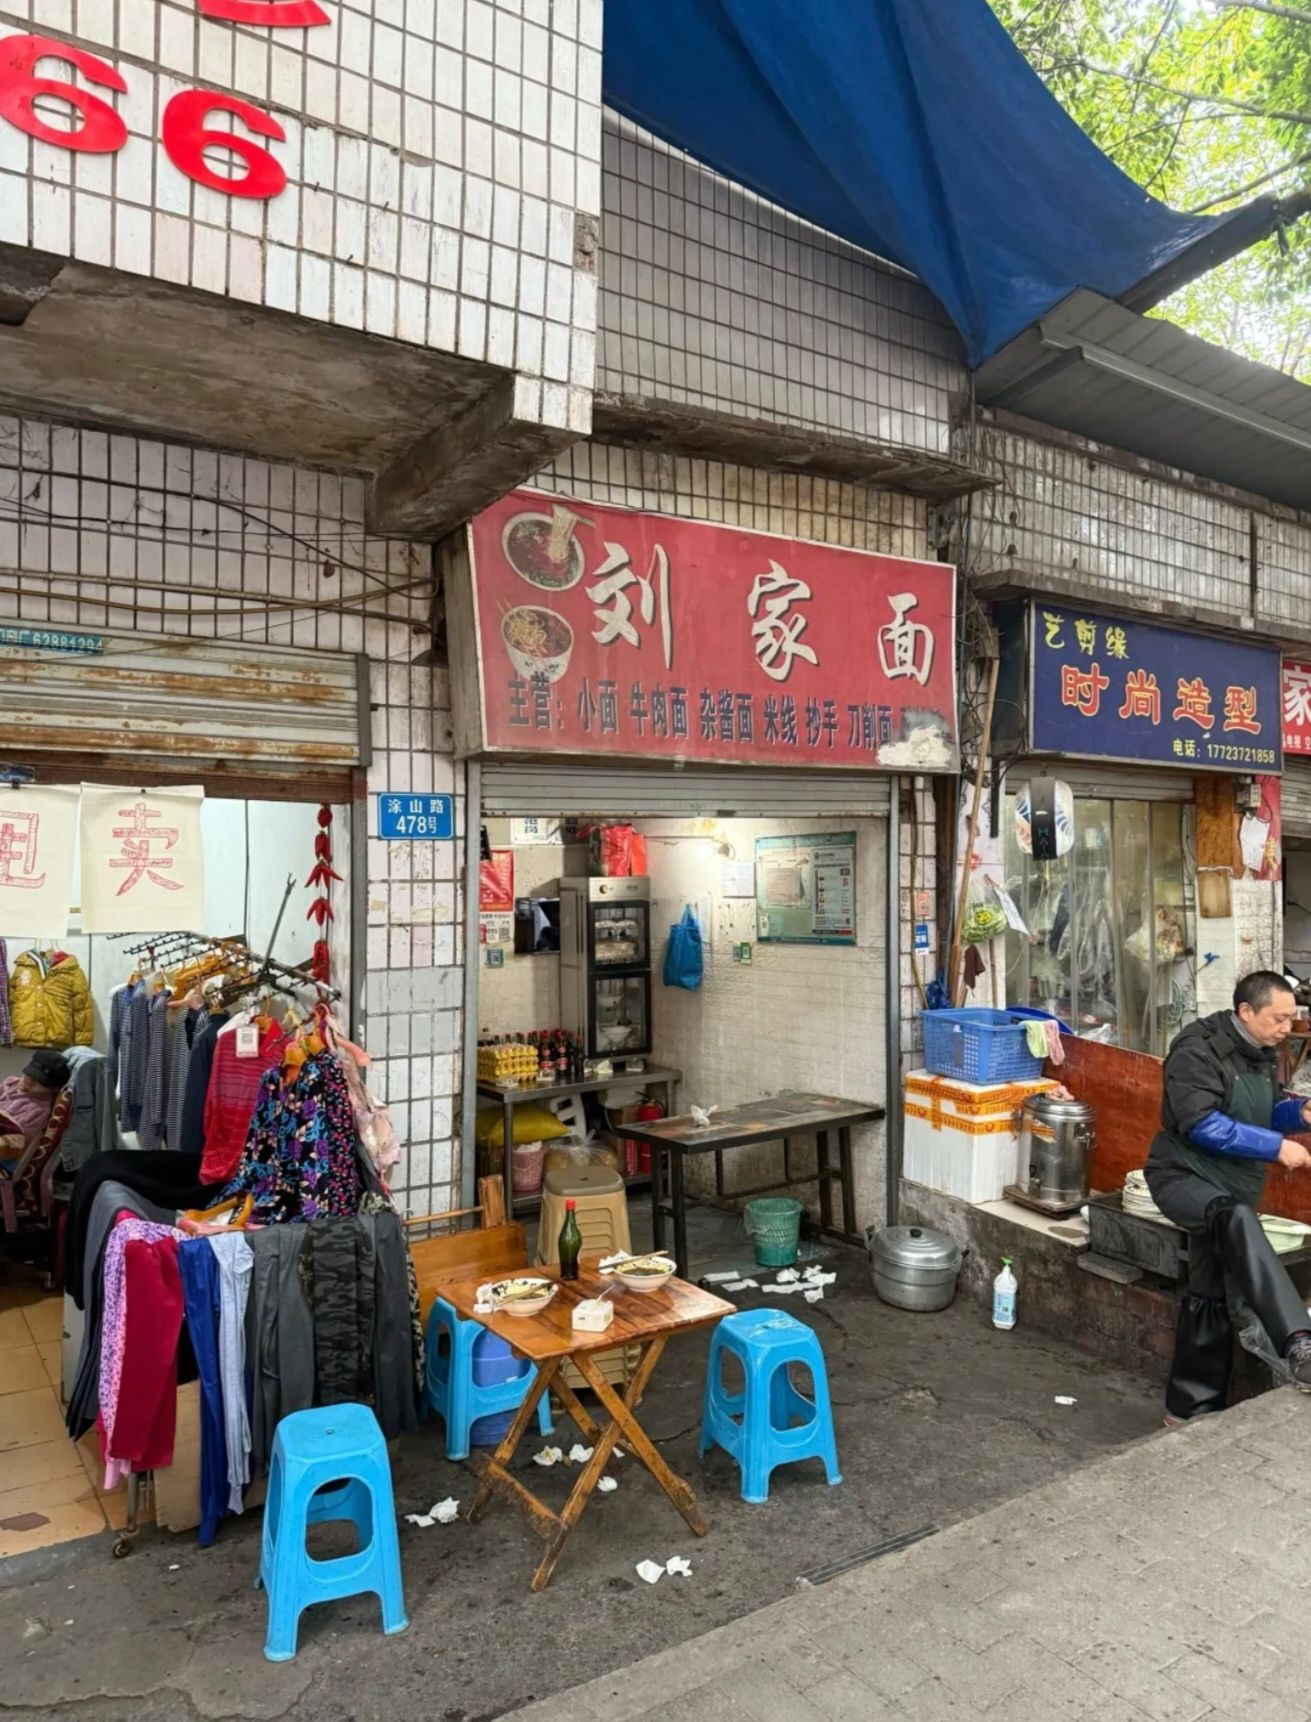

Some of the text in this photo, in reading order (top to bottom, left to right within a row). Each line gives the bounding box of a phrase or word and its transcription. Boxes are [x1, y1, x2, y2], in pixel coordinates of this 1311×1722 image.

[0, 34, 287, 199] 66
[584, 540, 935, 685] 刘家面
[1042, 611, 1130, 660] 艺剪缘
[577, 676, 619, 735] 小面
[630, 681, 689, 739] 牛肉面
[700, 687, 754, 744] 杂酱面
[763, 694, 798, 746] 米线
[805, 696, 839, 749] 抄手
[847, 702, 894, 751] 刀削面
[1060, 662, 1262, 735] 时尚造型
[1206, 744, 1276, 764] 17723721858
[387, 798, 444, 814] 涂山路
[396, 815, 438, 835] 478号
[108, 802, 185, 896] 卖
